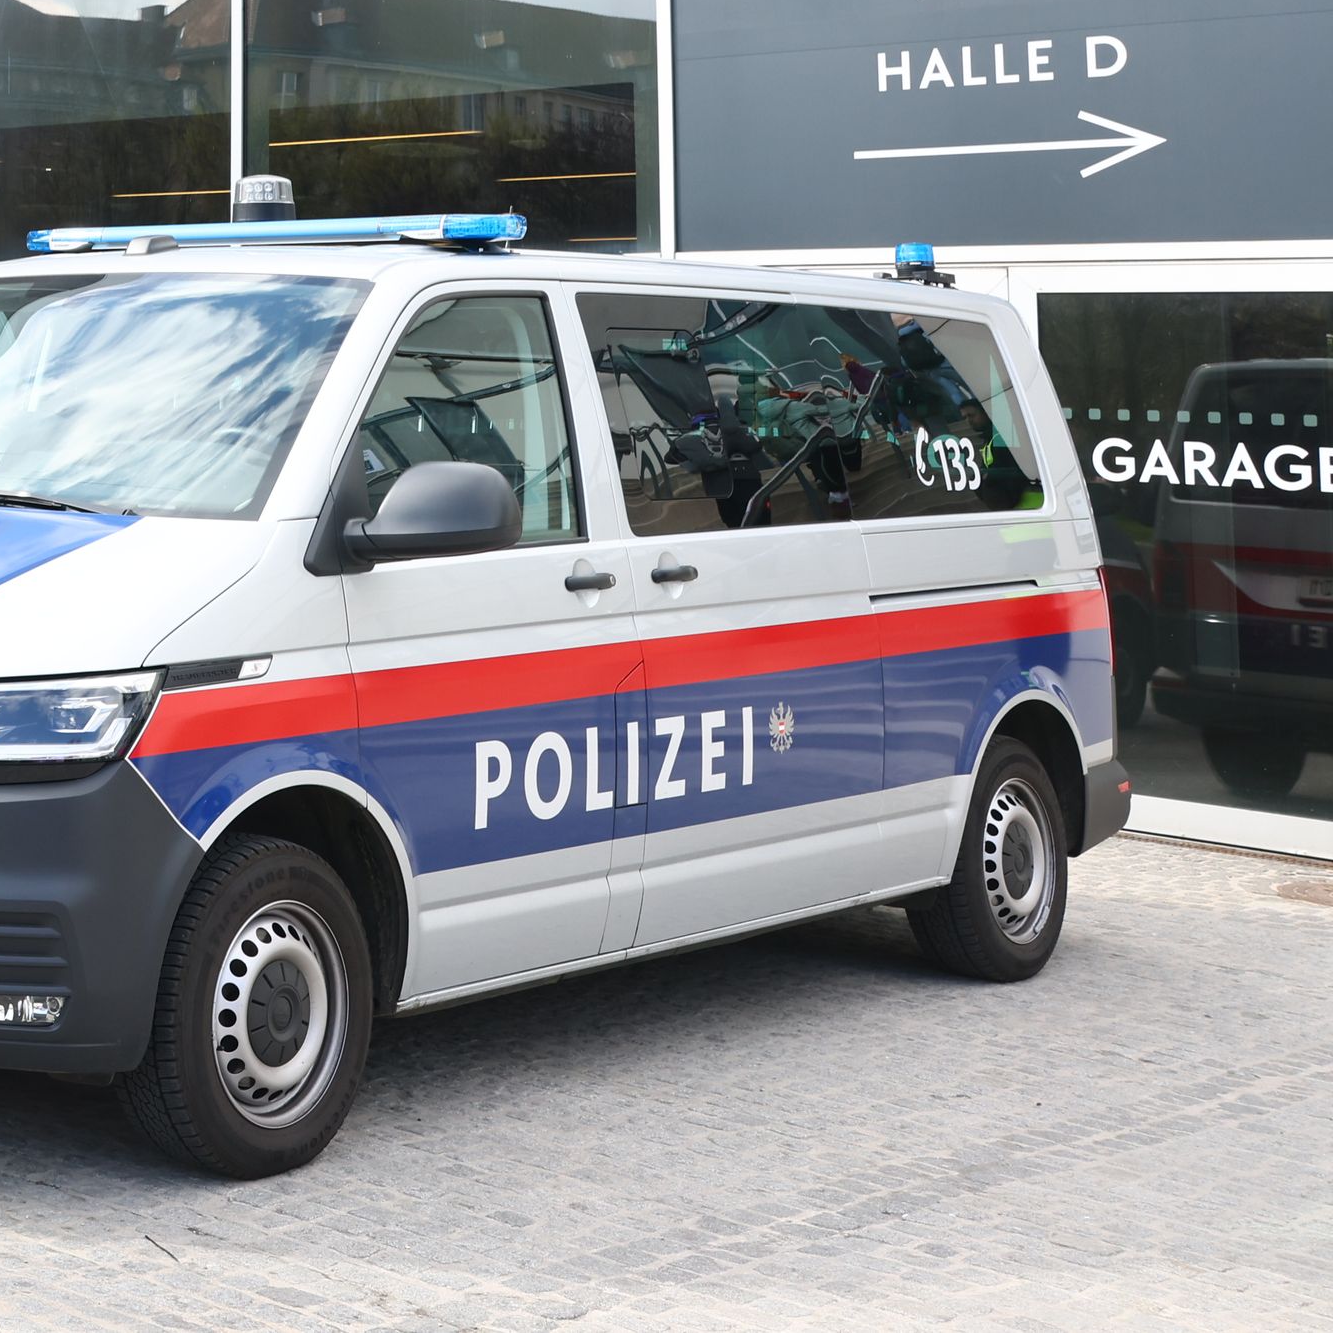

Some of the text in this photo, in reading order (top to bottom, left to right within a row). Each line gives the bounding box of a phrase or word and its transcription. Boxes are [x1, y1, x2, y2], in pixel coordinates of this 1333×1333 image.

[877, 34, 1128, 93] HALLE D
[932, 436, 982, 492] 133
[474, 705, 754, 831] POLIZEI
